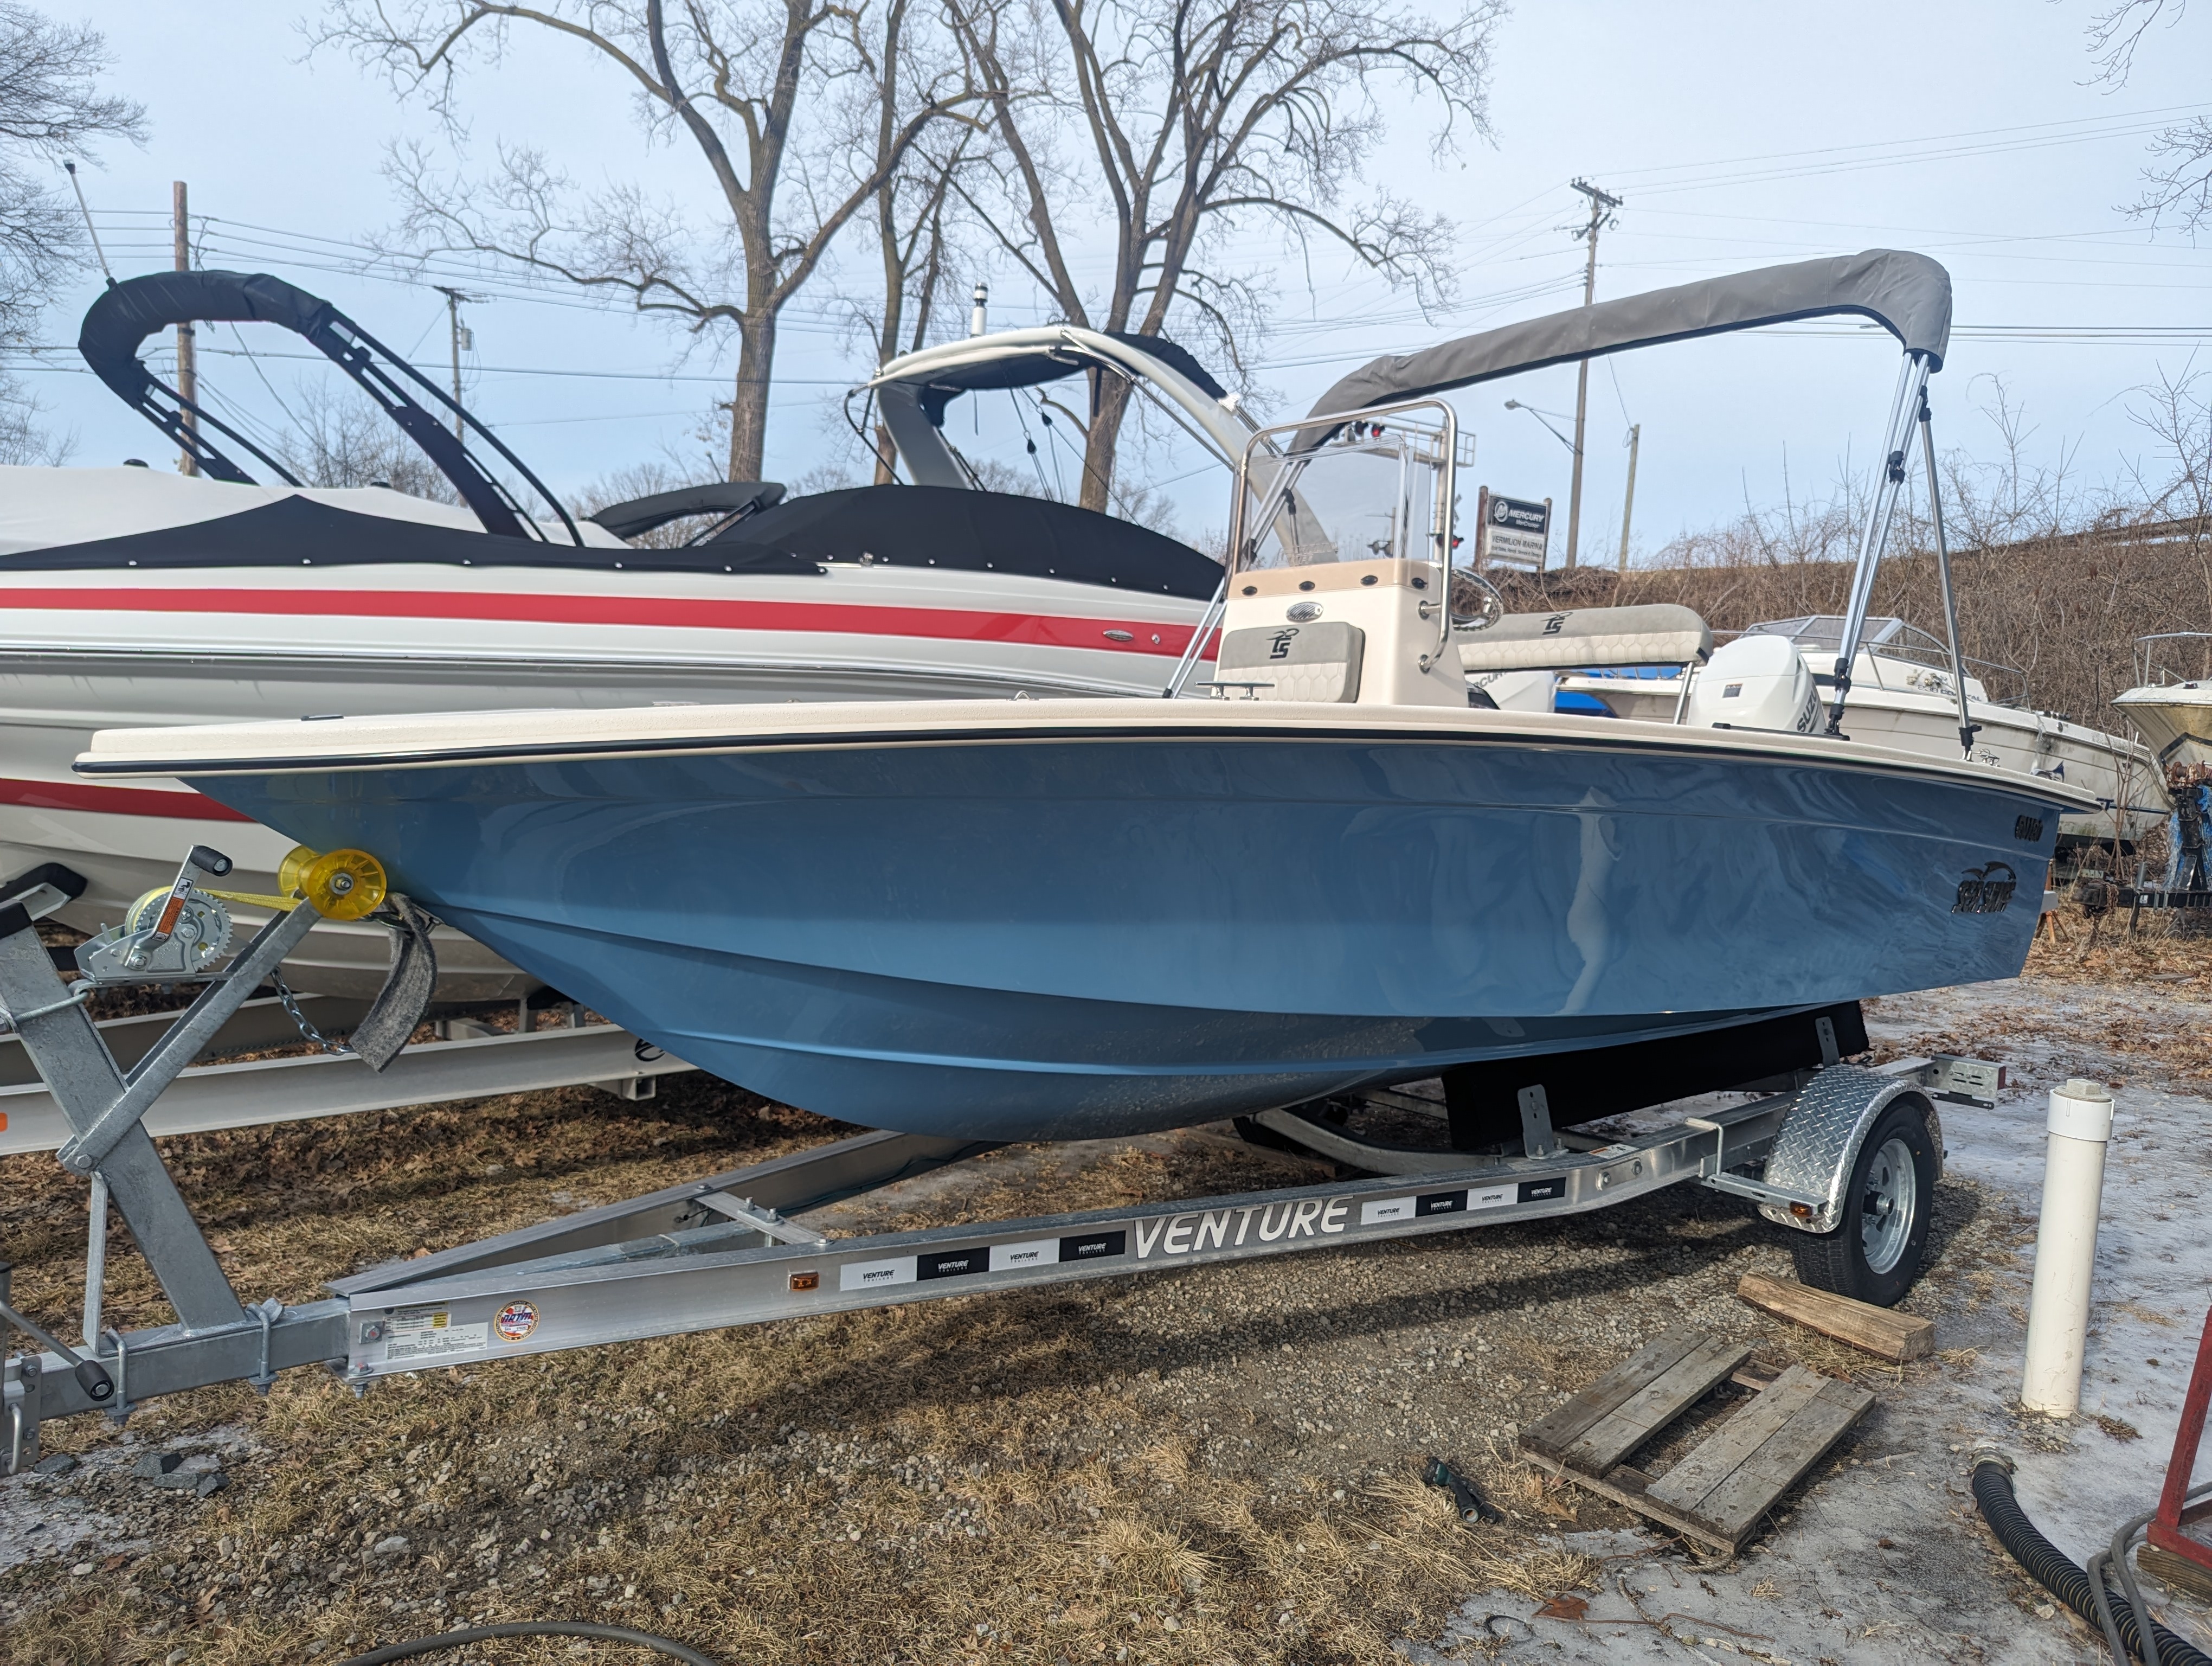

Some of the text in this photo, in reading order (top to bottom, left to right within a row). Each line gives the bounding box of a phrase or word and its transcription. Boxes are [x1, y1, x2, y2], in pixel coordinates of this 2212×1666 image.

[1508, 509, 1545, 522] MERCURY
[1492, 535, 1542, 550] VERMILION MARINA
[1134, 1195, 1354, 1259] VENTURE
[1078, 1243, 1107, 1251] VENTURE
[1010, 1251, 1039, 1260] VENTURE
[937, 1260, 969, 1270] VENTURE
[863, 1270, 895, 1279] VENTURE
